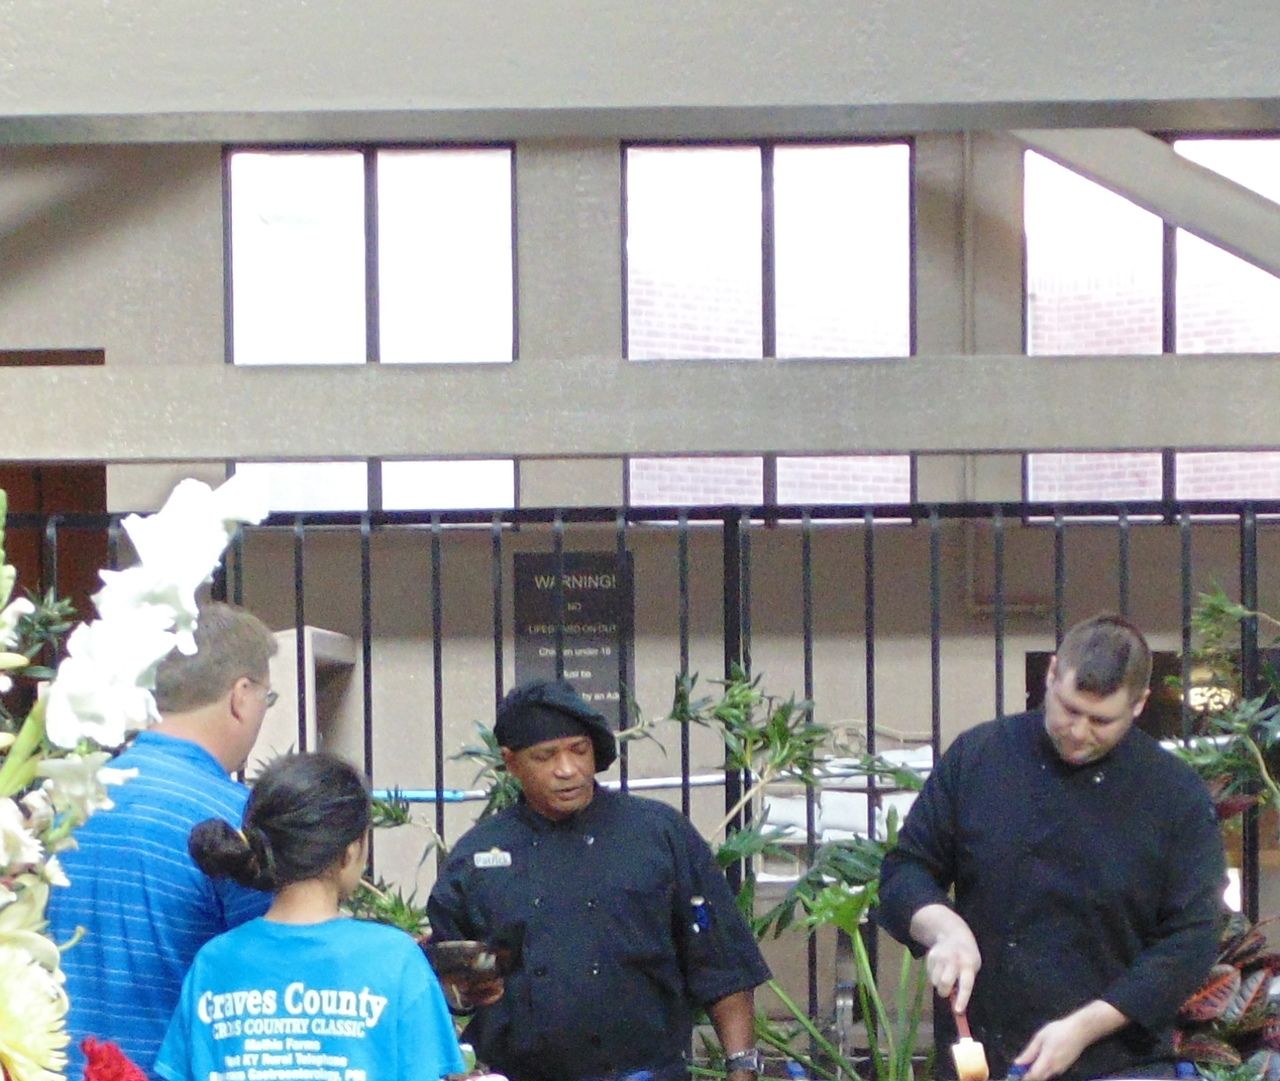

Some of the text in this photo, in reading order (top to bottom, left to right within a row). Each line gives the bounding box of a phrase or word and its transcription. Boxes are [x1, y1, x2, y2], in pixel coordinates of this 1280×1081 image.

[284, 982, 388, 1028] County
[244, 1018, 309, 1035] COUNTRY
[311, 1019, 365, 1038] CLASSIC
